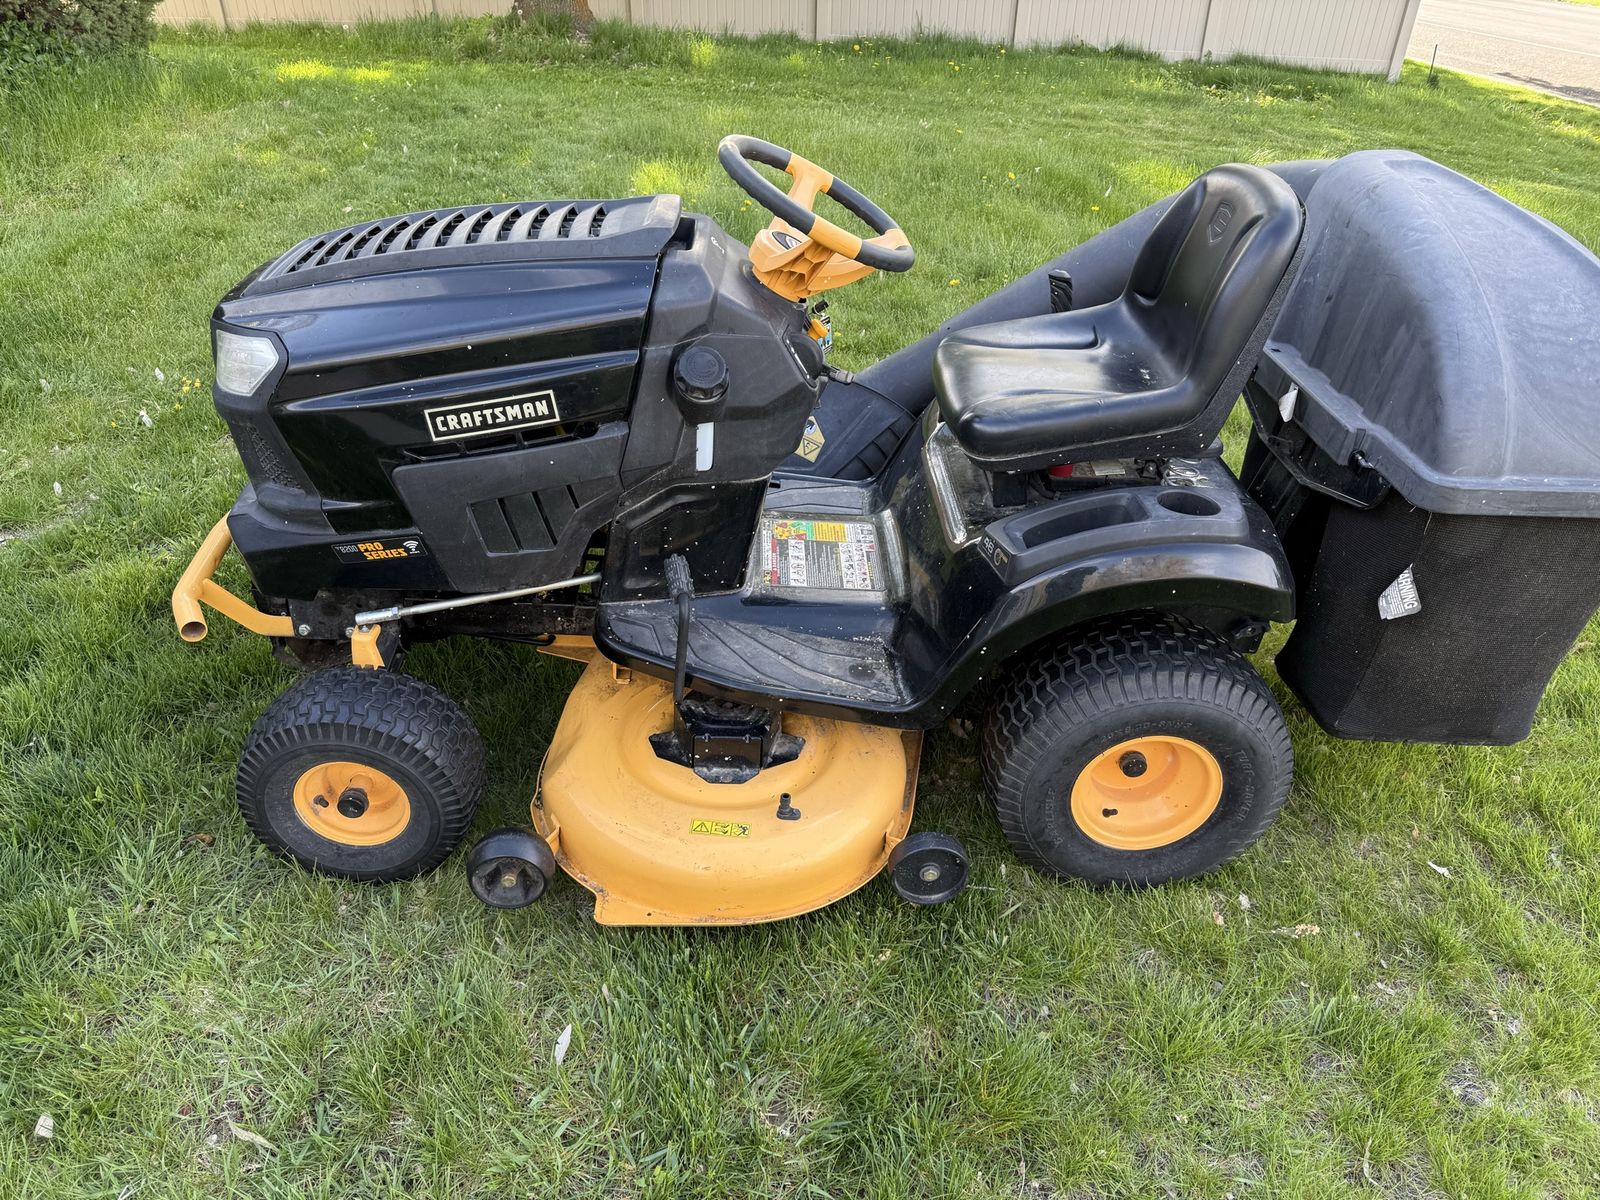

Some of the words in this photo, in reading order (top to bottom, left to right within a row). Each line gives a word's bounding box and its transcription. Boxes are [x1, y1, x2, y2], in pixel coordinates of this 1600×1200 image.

[435, 400, 549, 432] CRAFTSMAN
[357, 542, 384, 552] PRO
[363, 548, 408, 560] SERIES
